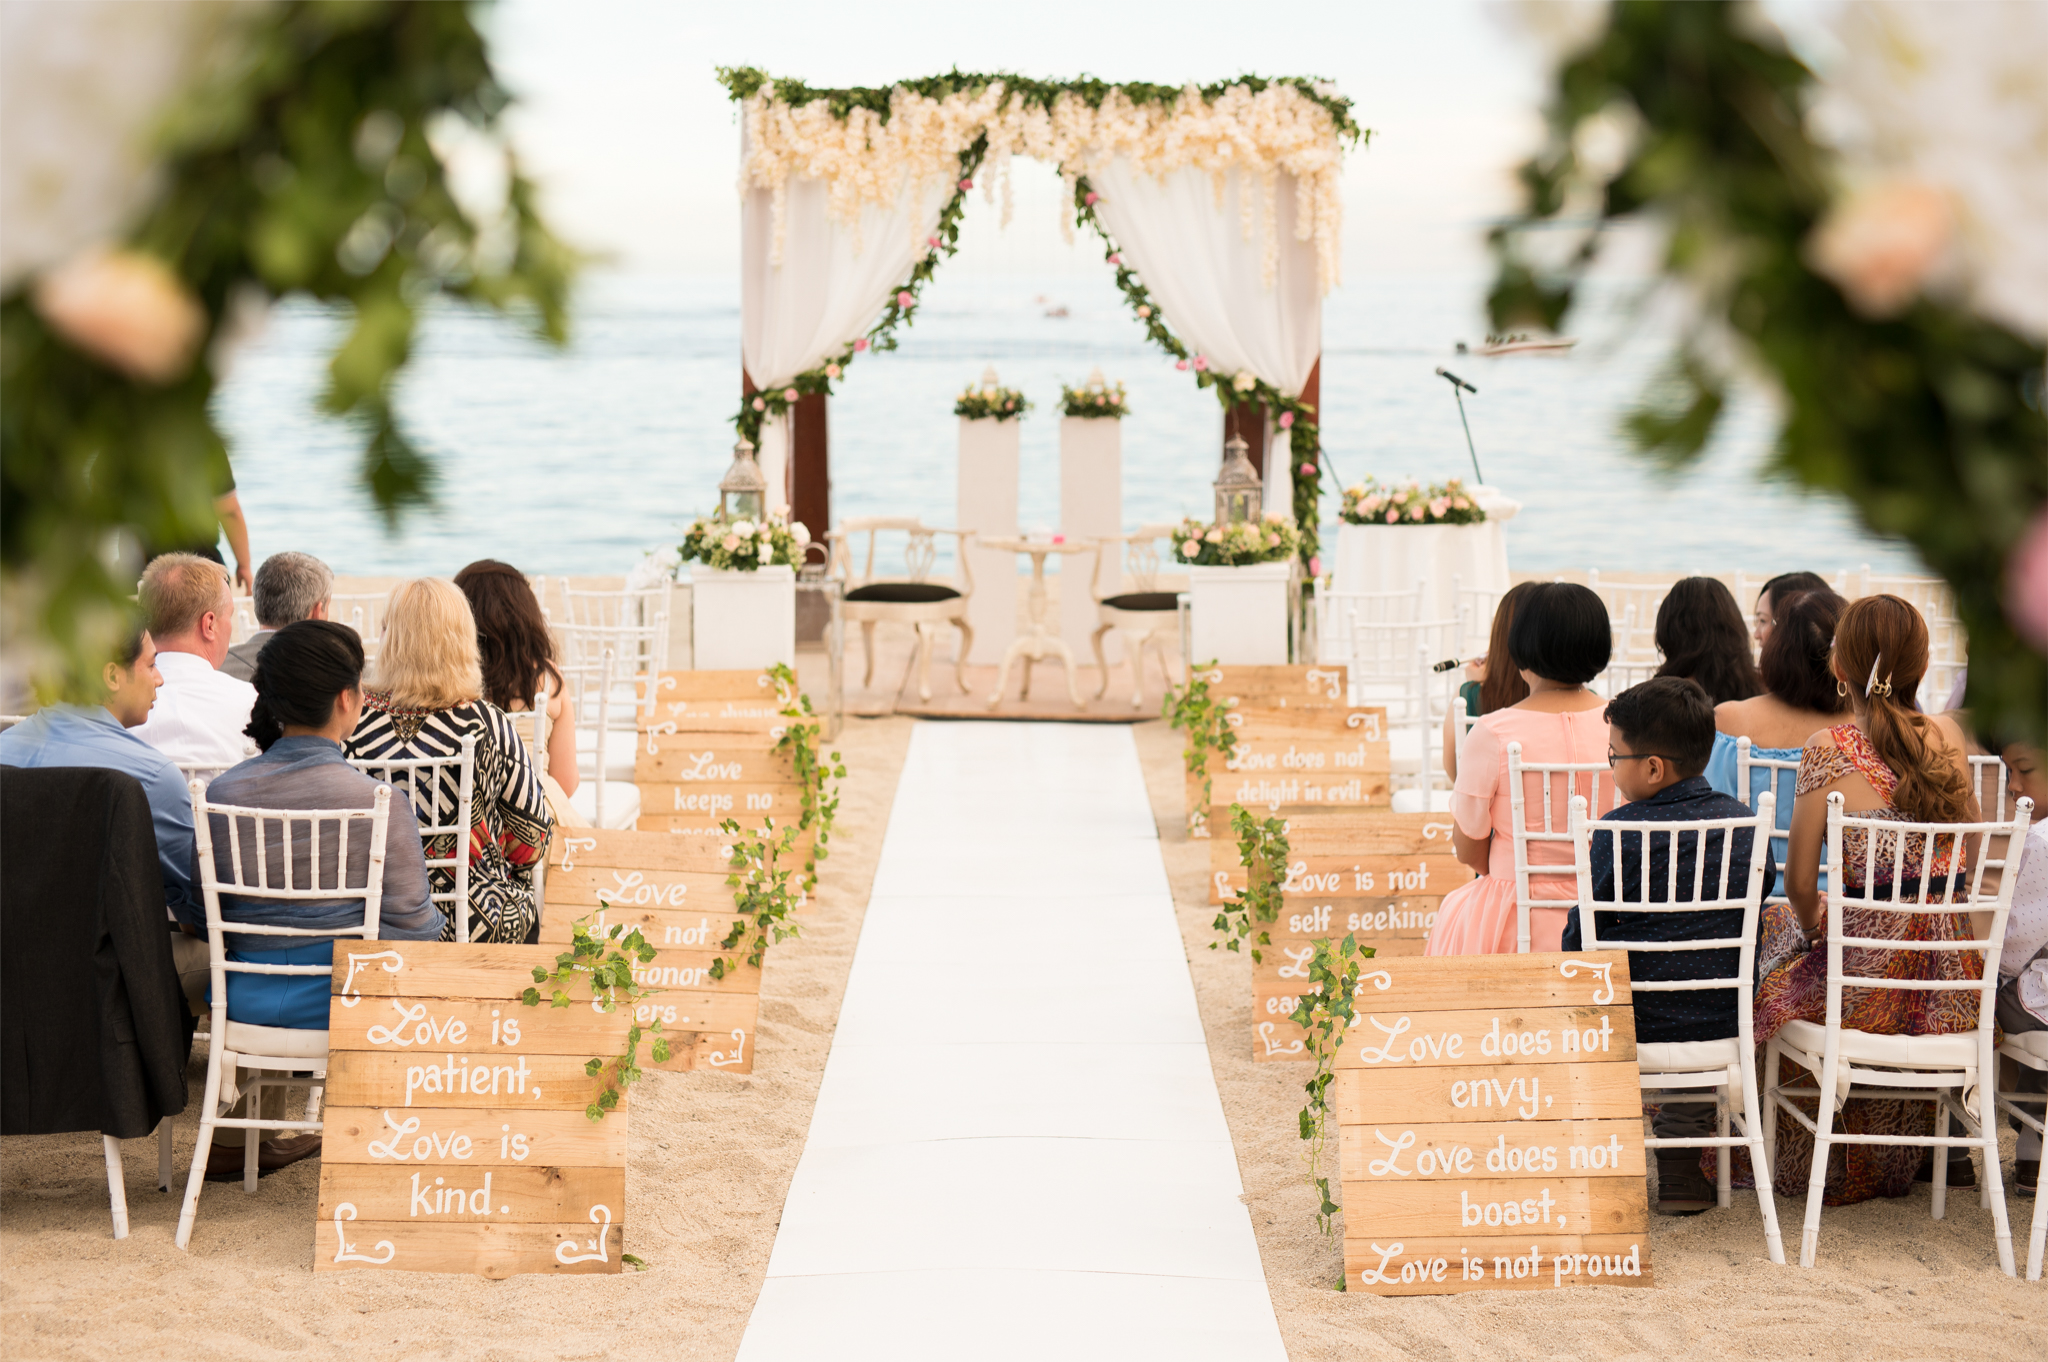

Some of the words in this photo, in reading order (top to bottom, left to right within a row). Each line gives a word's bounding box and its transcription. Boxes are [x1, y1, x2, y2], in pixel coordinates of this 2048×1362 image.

[681, 752, 742, 780] Love
[1227, 744, 1276, 769] Love
[1282, 746, 1325, 768] does
[1335, 744, 1366, 767] not
[675, 787, 733, 818] keeps
[747, 794, 772, 809] no
[1236, 779, 1300, 810] delight
[1304, 781, 1322, 800] in
[1327, 780, 1368, 801] evil.
[596, 871, 687, 906] Love
[1280, 861, 1340, 892] Love
[1354, 865, 1374, 890] is
[1388, 862, 1429, 889] not
[665, 918, 709, 944] not
[1290, 905, 1332, 933] self
[367, 999, 467, 1046] Love
[492, 1010, 521, 1046] is
[1361, 1015, 1464, 1063] Love
[1481, 1017, 1552, 1056] does
[1562, 1015, 1613, 1053] not
[405, 1054, 541, 1106] patient,
[1451, 1077, 1553, 1119] envy,
[368, 1110, 473, 1160] Love
[501, 1124, 529, 1161] is
[1369, 1129, 1473, 1176] Love
[1486, 1134, 1557, 1172] does
[1569, 1134, 1623, 1169] not
[411, 1172, 509, 1217] kind.
[1461, 1188, 1566, 1228] boast,
[1362, 1242, 1447, 1285] Love
[1461, 1248, 1484, 1280] is
[1493, 1245, 1543, 1279] not
[1553, 1244, 1641, 1287] proud
